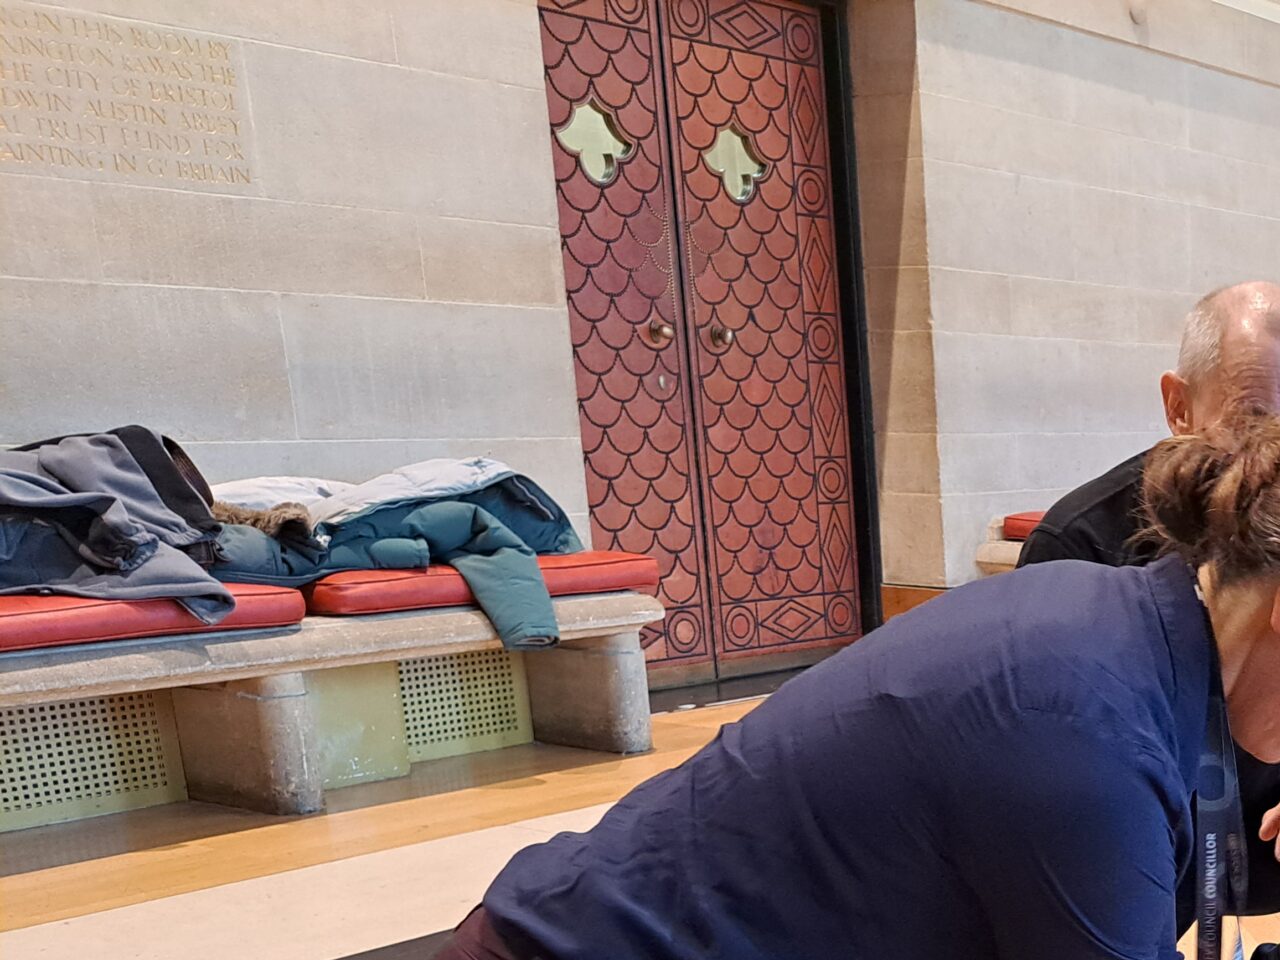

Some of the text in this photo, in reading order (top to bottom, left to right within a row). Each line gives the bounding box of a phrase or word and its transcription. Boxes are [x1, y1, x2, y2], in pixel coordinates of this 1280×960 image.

[66, 17, 123, 43] THIS
[129, 26, 202, 56] ROOM
[207, 39, 232, 62] BY
[45, 66, 101, 93] CITY
[111, 76, 141, 98] OF
[148, 80, 237, 111] BRISTOL
[86, 98, 167, 126] AUSTIN
[31, 117, 107, 146] TRUST
[120, 127, 192, 155] FUND
[203, 138, 246, 162] FOR
[112, 151, 138, 174] IN
[176, 160, 251, 184] BRITAIN
[1204, 832, 1218, 899] COUNCILLOR
